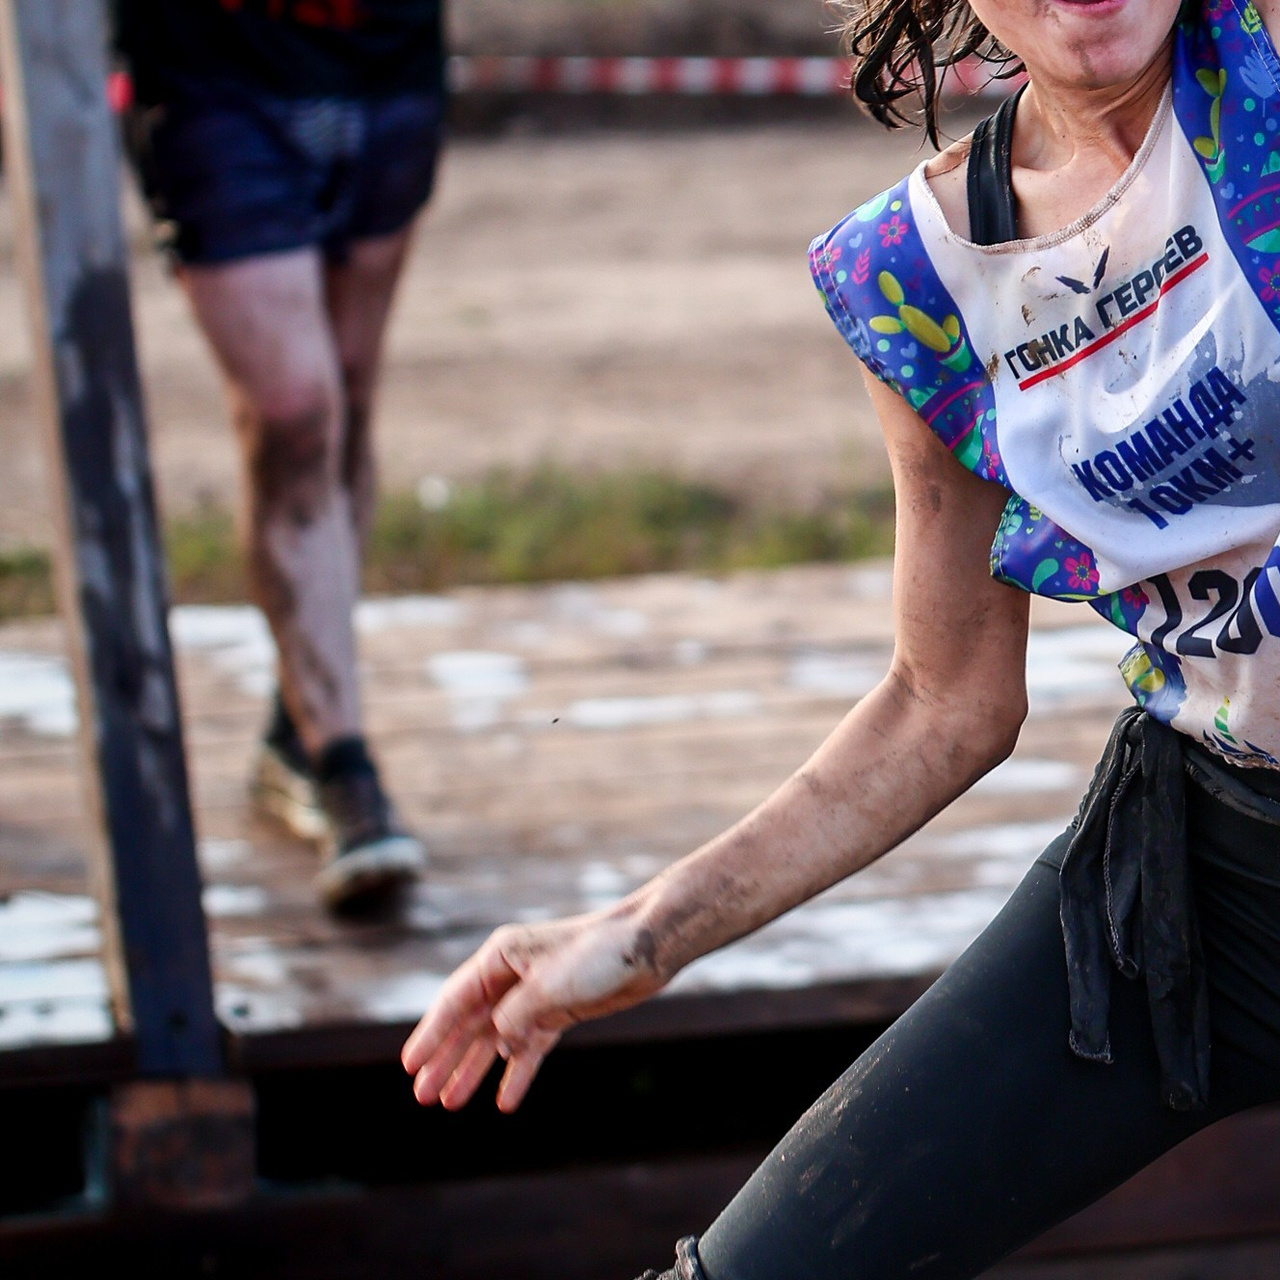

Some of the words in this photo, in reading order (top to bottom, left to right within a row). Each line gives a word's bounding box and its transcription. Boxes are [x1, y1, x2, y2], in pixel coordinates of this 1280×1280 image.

[1004, 316, 1095, 380] ГОНКА
[1071, 366, 1247, 502] КОМАНДА
[1128, 438, 1256, 530] 10КМ+
